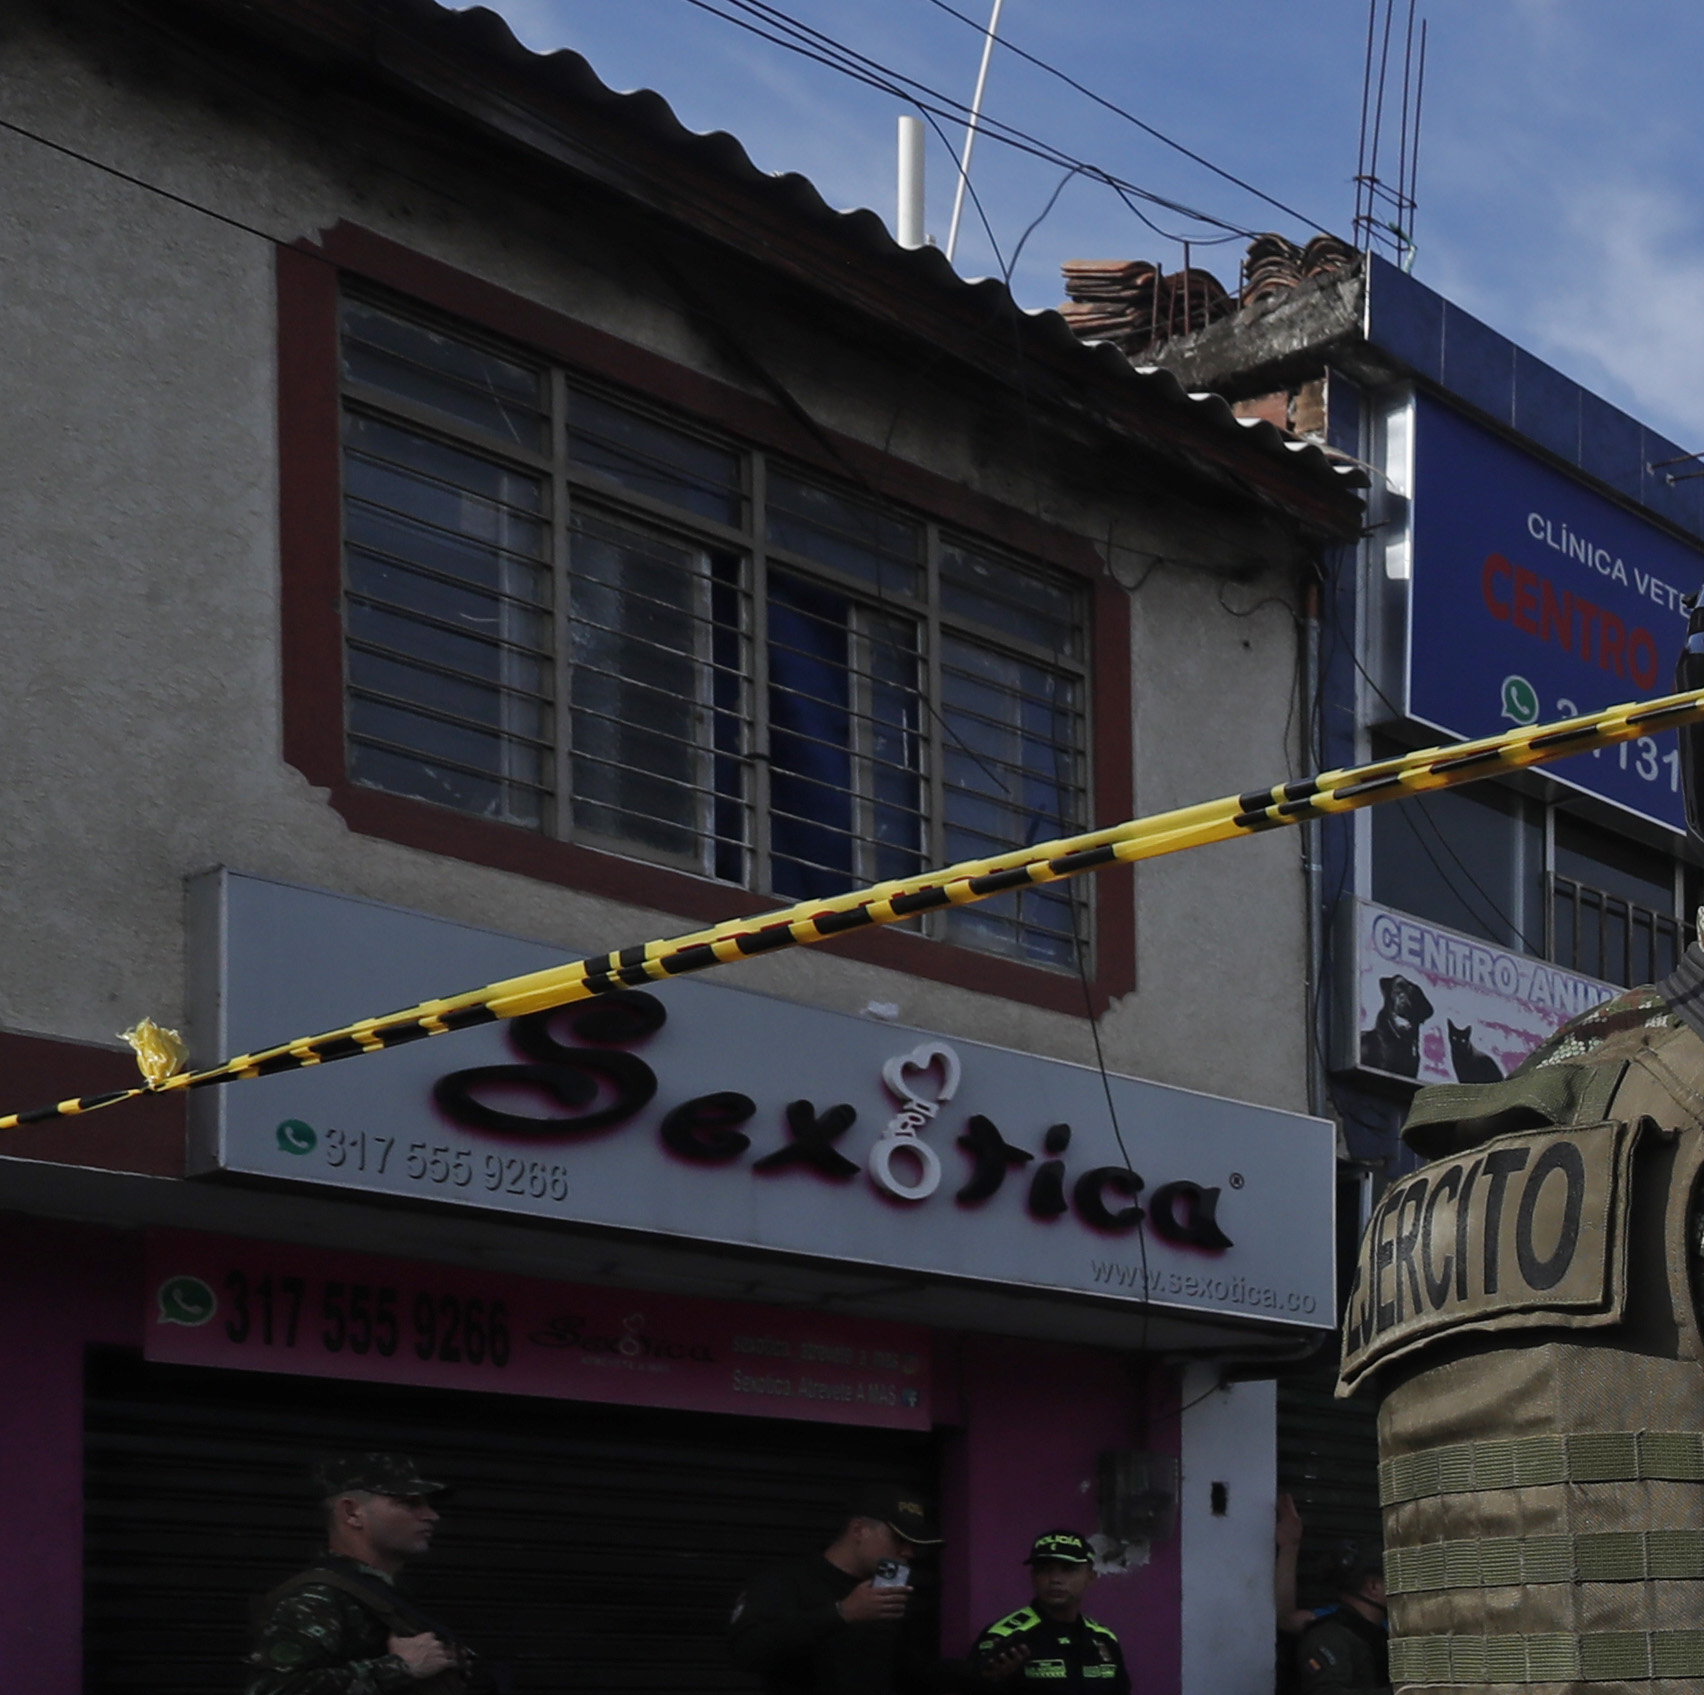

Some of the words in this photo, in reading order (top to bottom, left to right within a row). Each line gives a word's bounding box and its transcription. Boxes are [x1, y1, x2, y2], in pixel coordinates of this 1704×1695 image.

[1482, 553, 1658, 691] CENTRO
[1373, 914, 1519, 996] CENTRO
[325, 1128, 396, 1174] 317
[407, 1142, 472, 1187] 555
[484, 1154, 569, 1202] 9266
[225, 1269, 306, 1347] 317
[322, 1282, 399, 1357] 555
[413, 1290, 511, 1368] 9266
